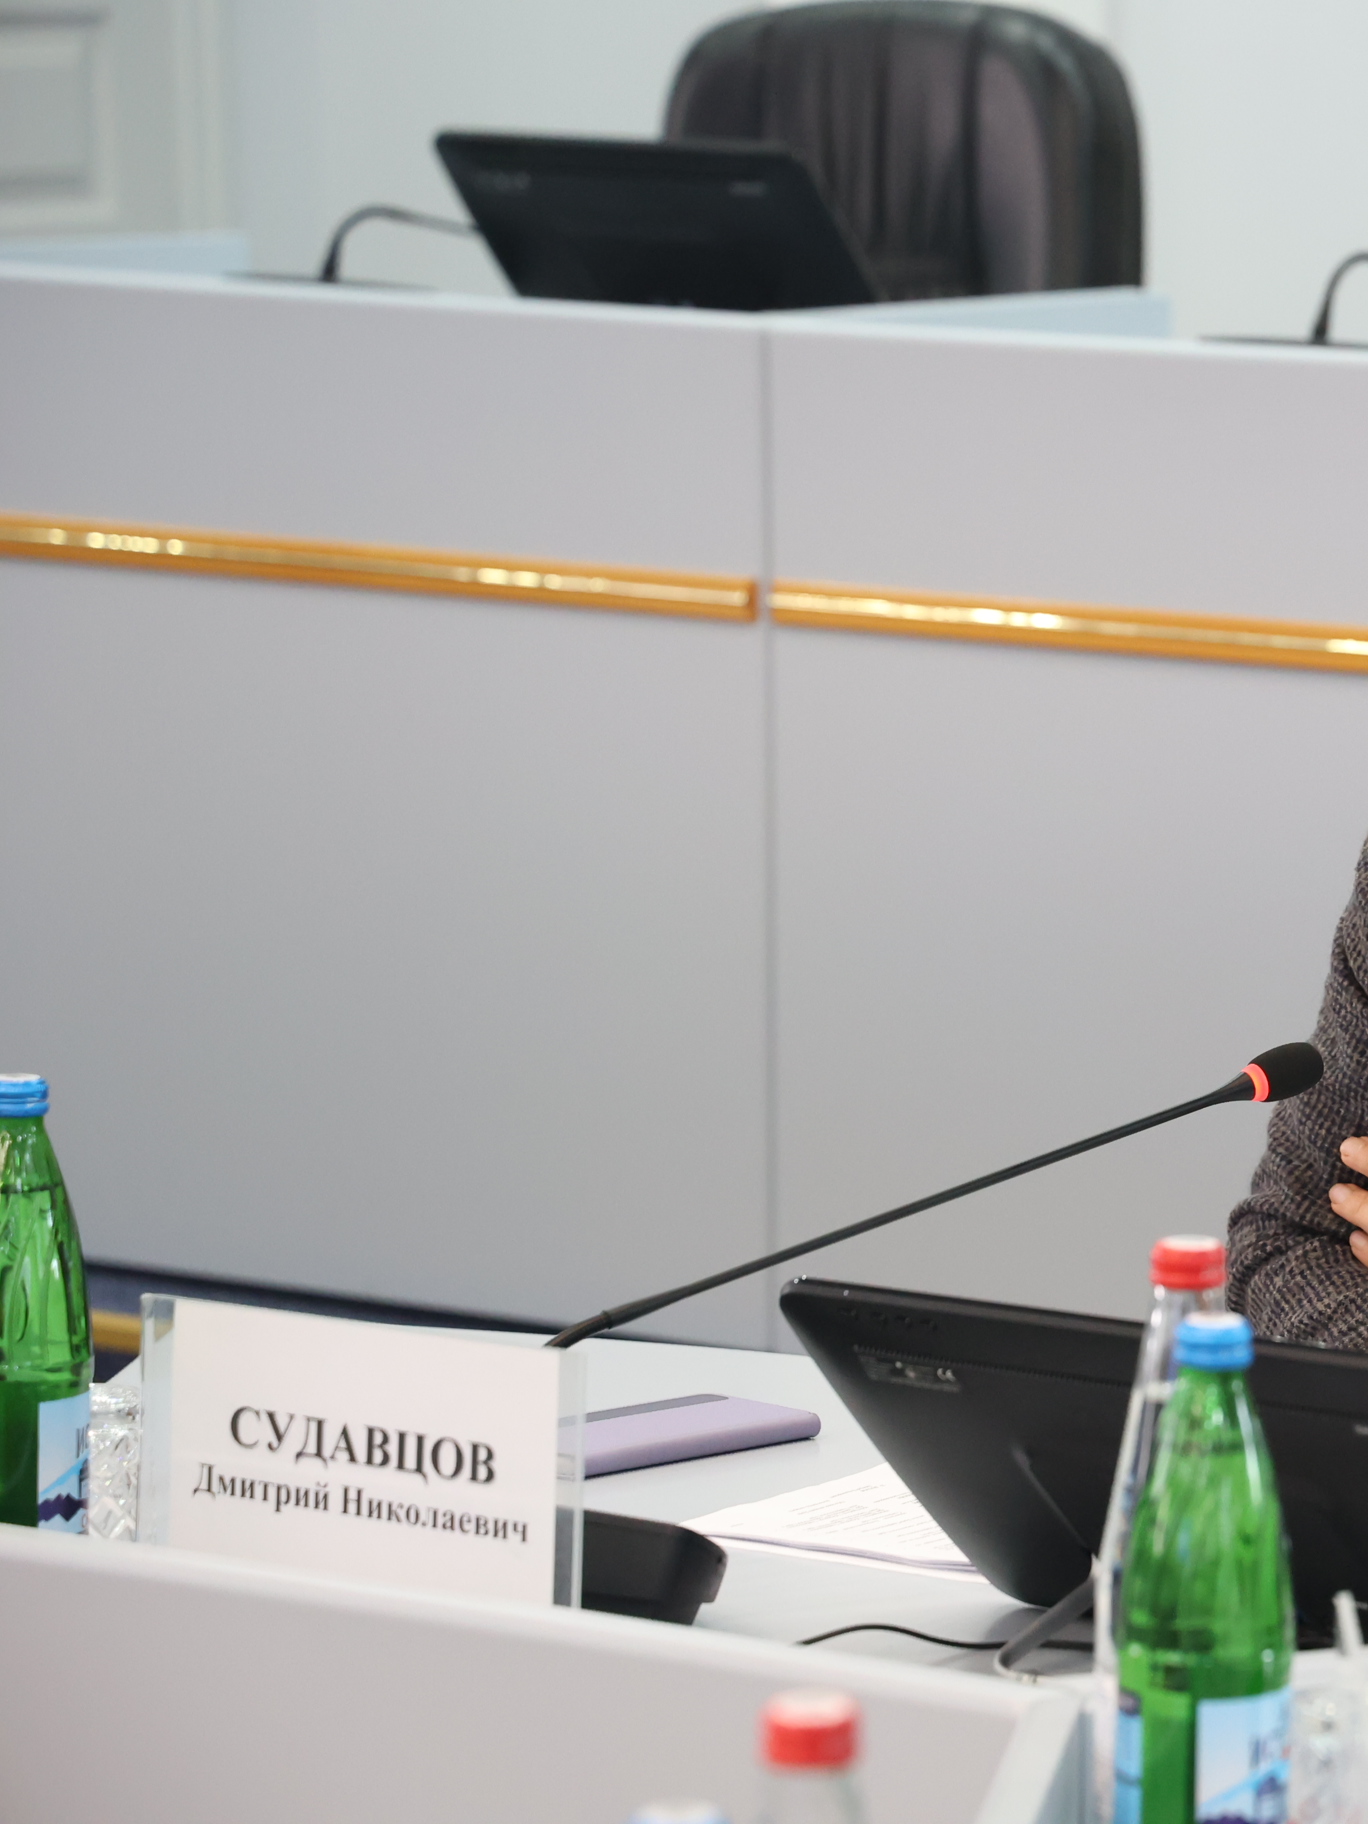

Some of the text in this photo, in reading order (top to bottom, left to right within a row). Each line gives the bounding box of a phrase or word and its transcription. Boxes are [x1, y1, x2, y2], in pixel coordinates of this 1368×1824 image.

[230, 1405, 496, 1485] СУДАВЦОВ
[193, 1462, 529, 1543] Дмитрий Николаевич
